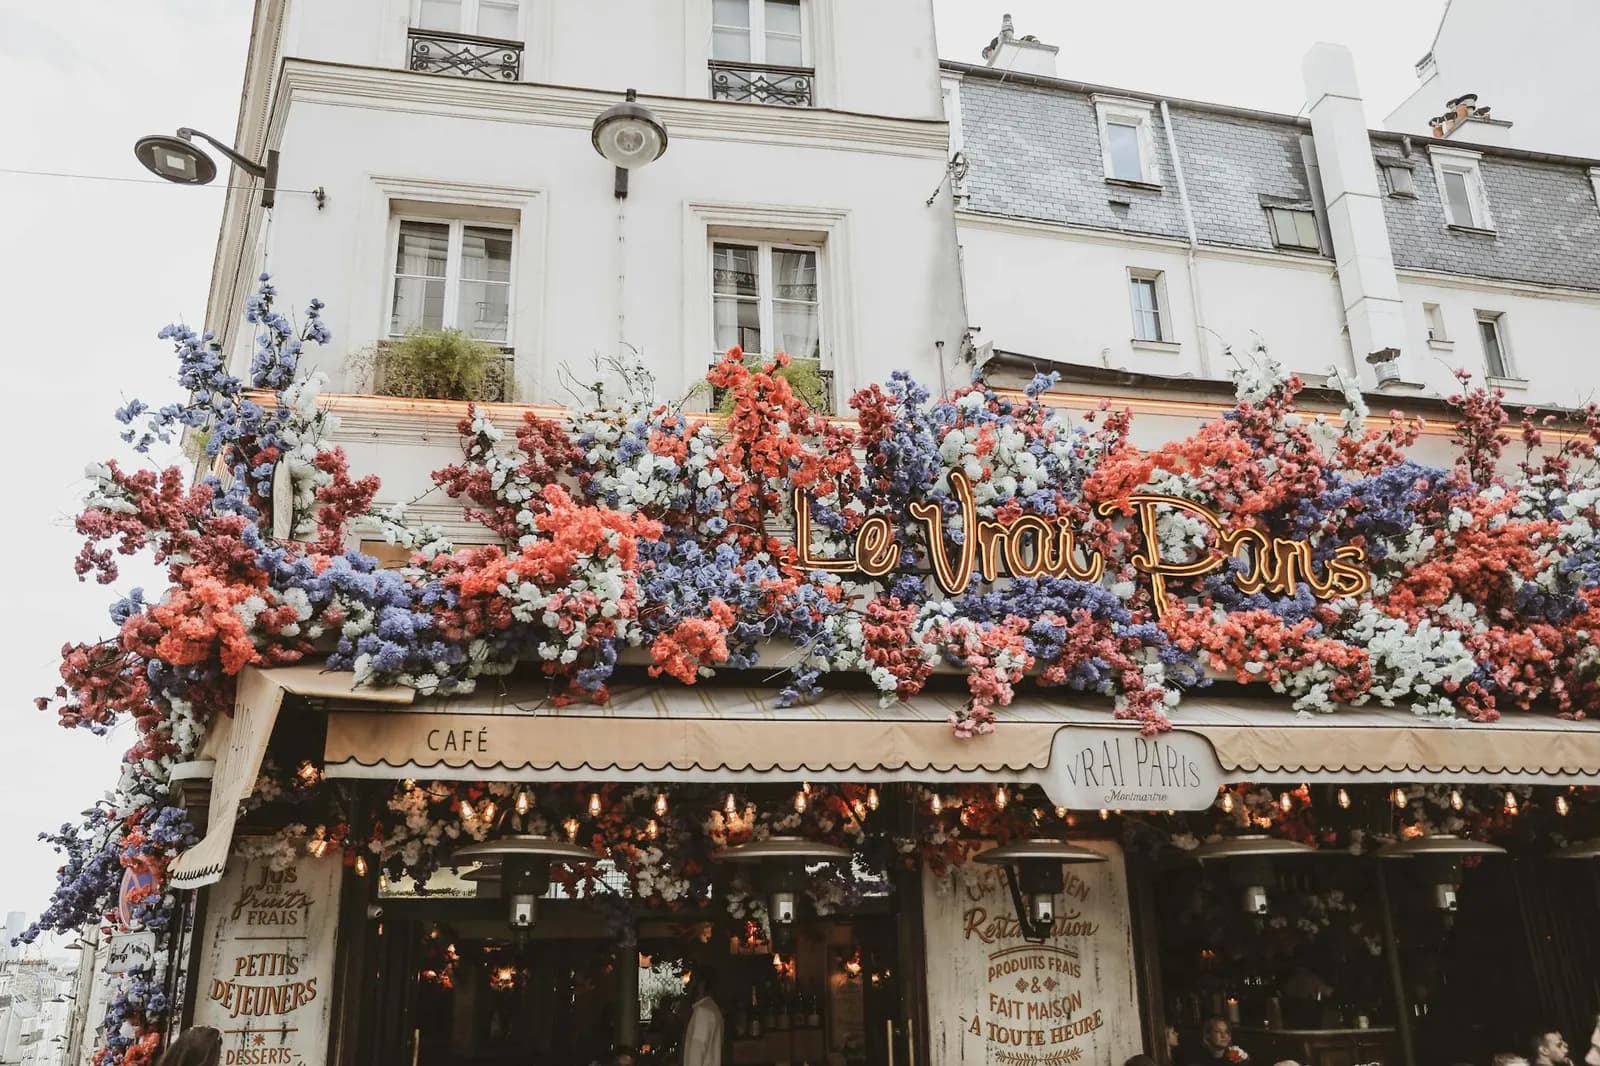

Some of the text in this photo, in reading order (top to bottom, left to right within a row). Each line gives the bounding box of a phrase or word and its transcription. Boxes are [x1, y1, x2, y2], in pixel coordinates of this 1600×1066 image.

[780, 466, 1372, 618] Le Vrai Paris
[427, 726, 488, 752] CAFÉ
[1066, 737, 1201, 788] VRAI PARIS
[1104, 788, 1168, 803] Montmartre
[255, 865, 298, 891] JUS
[231, 886, 316, 921] fruits
[247, 910, 299, 926] FRAIS
[234, 952, 300, 977] PETITS
[988, 955, 1081, 983] PRODUITS FRAIS
[210, 976, 318, 1019] DÉJEUNERS
[1031, 976, 1041, 994] &
[989, 990, 1083, 1021] FAIT MAISON
[986, 1021, 1046, 1047] TOUTE
[1050, 1009, 1104, 1045] HEURE
[225, 1047, 292, 1066] DESSERTS
